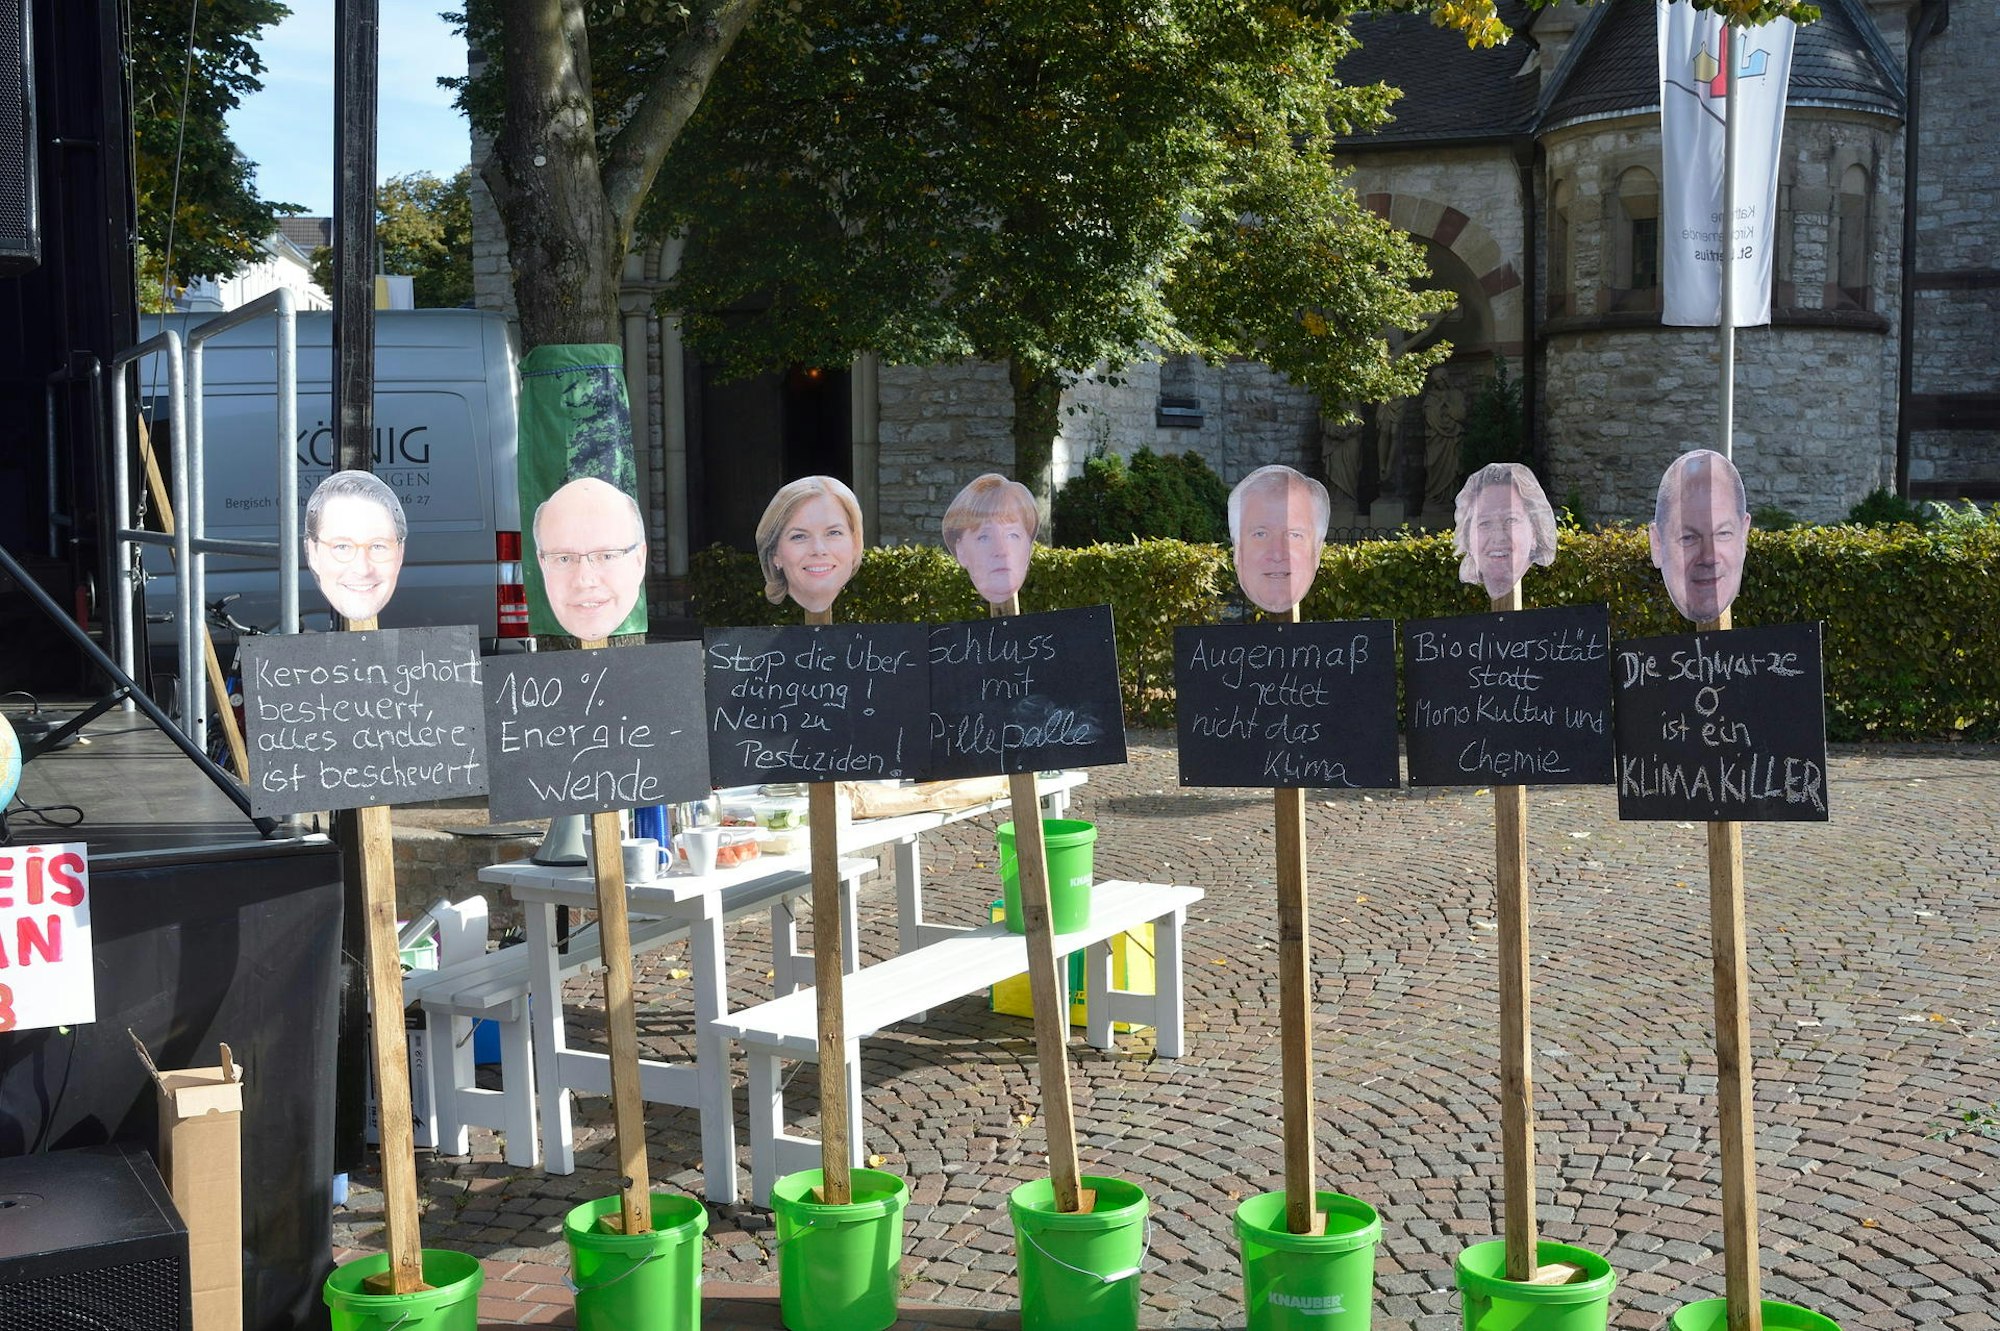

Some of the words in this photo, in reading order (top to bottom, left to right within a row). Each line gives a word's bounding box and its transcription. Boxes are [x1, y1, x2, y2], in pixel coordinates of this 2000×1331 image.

[225, 495, 271, 509] Bergisch
[417, 494, 430, 505] 27
[709, 643, 786, 682] Stop
[795, 640, 836, 671] die
[847, 633, 917, 674] Über-
[1190, 634, 1369, 689] Augenmaß
[1413, 628, 1605, 662] Biodiversität
[256, 657, 390, 690] Kerosin
[394, 649, 483, 695] gehört
[981, 665, 1034, 700] mit
[1617, 651, 1661, 689] Die
[257, 689, 433, 723] besteuert,
[496, 671, 563, 715] 100
[581, 667, 608, 716] %
[1250, 673, 1330, 708] rettet
[258, 728, 338, 752] alles
[353, 721, 467, 750] andere
[714, 705, 788, 732] Nein
[800, 712, 831, 731] zu
[1192, 705, 1259, 739] nicht
[1265, 714, 1321, 744] das
[1661, 711, 1690, 742] ist
[1702, 716, 1752, 747] ein
[262, 761, 306, 792] ist
[320, 748, 480, 789] bescheuert
[1264, 750, 1362, 788] Klima
[1458, 738, 1571, 774] Chemie
[1268, 1292, 1342, 1309] KNAUBER
